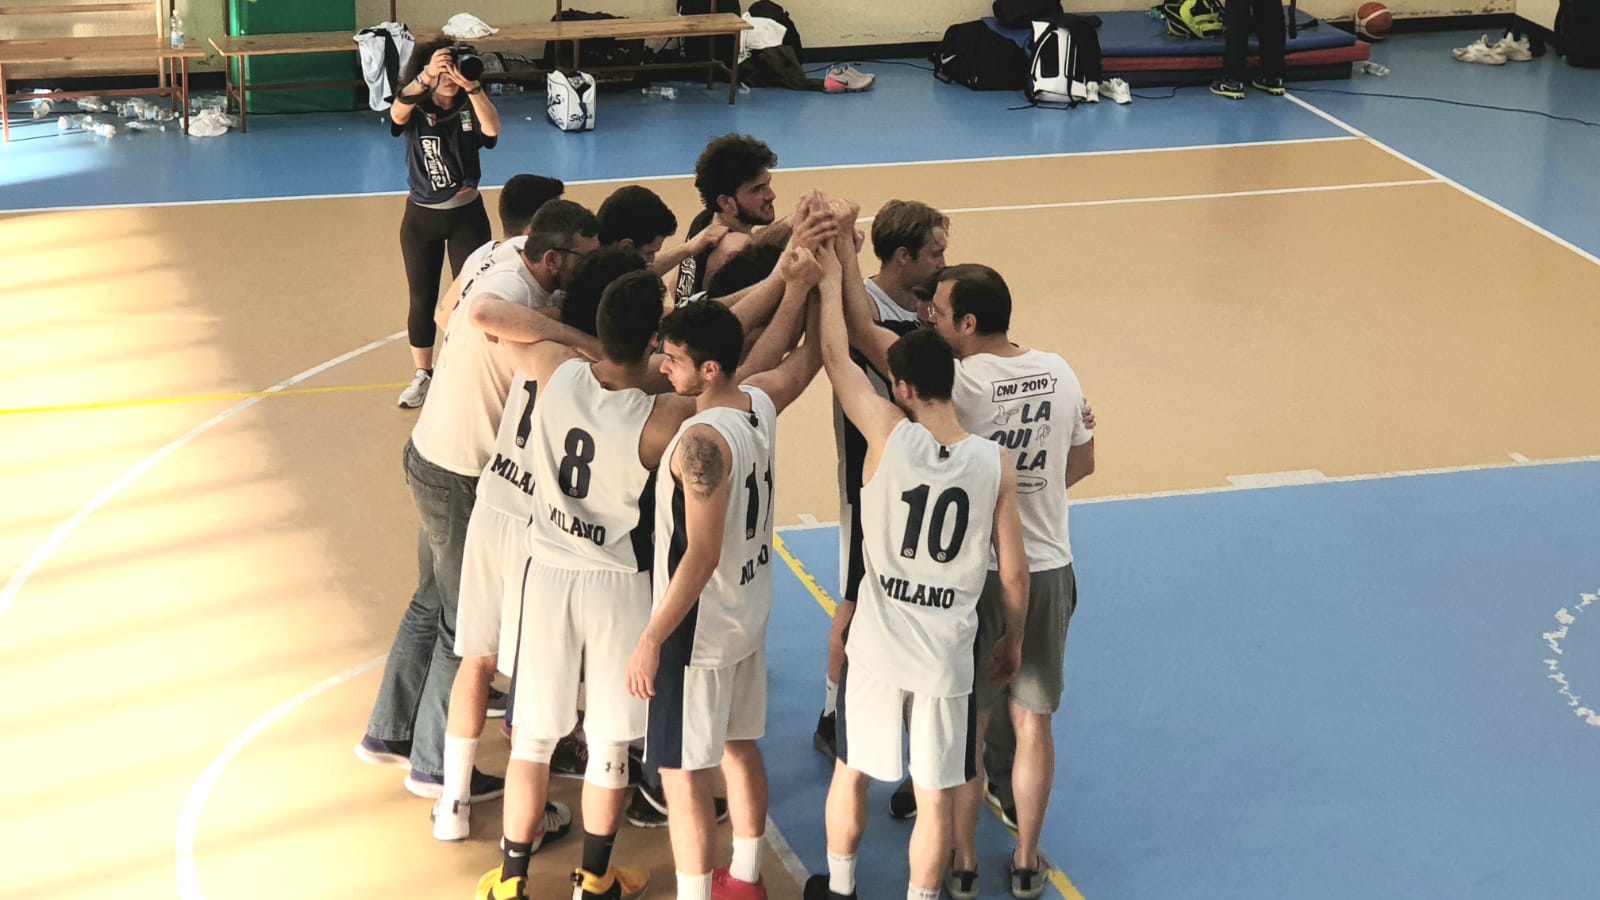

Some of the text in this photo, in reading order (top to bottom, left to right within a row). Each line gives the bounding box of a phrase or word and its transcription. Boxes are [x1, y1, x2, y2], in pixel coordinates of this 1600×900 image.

[996, 378, 1048, 397] CNU 2019
[1021, 400, 1051, 424] LA
[558, 427, 596, 499] 8
[1015, 449, 1047, 471] LA
[745, 456, 773, 541] 11
[548, 503, 607, 546] MILANO
[901, 484, 970, 563] 10
[880, 575, 955, 609] MILANO
